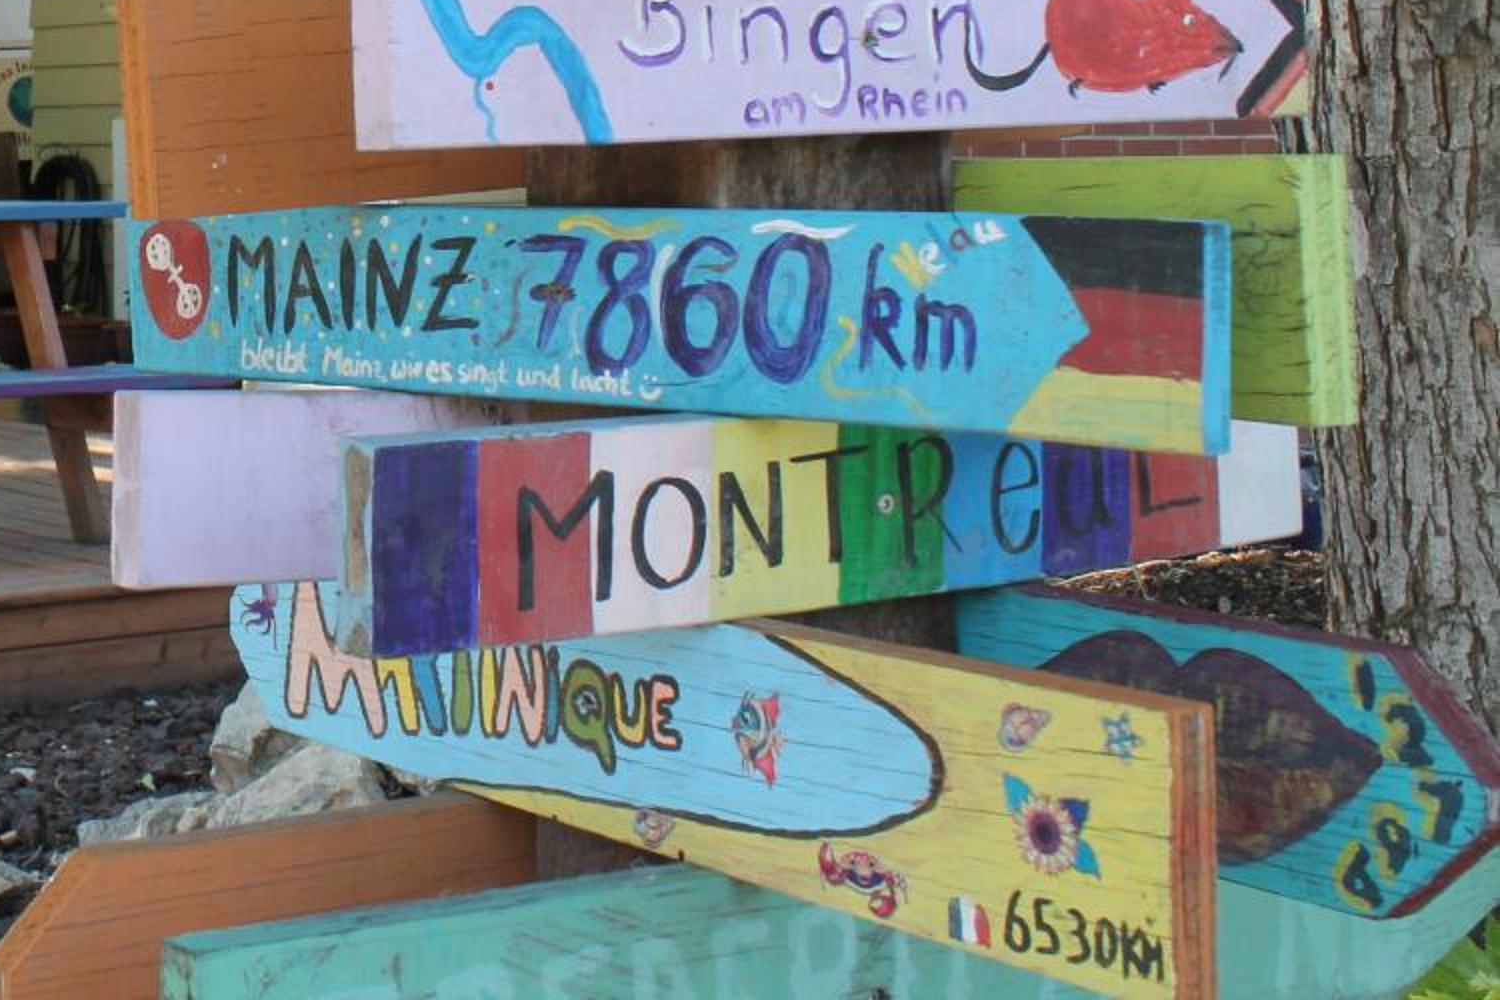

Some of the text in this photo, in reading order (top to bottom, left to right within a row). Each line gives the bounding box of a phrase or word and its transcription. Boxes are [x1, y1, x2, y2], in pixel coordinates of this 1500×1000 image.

[742, 74, 969, 129] am Rhein
[227, 232, 978, 385] MAINZ 7860 km
[240, 336, 309, 374] bleibt
[457, 359, 507, 394] singt
[515, 362, 561, 390] und
